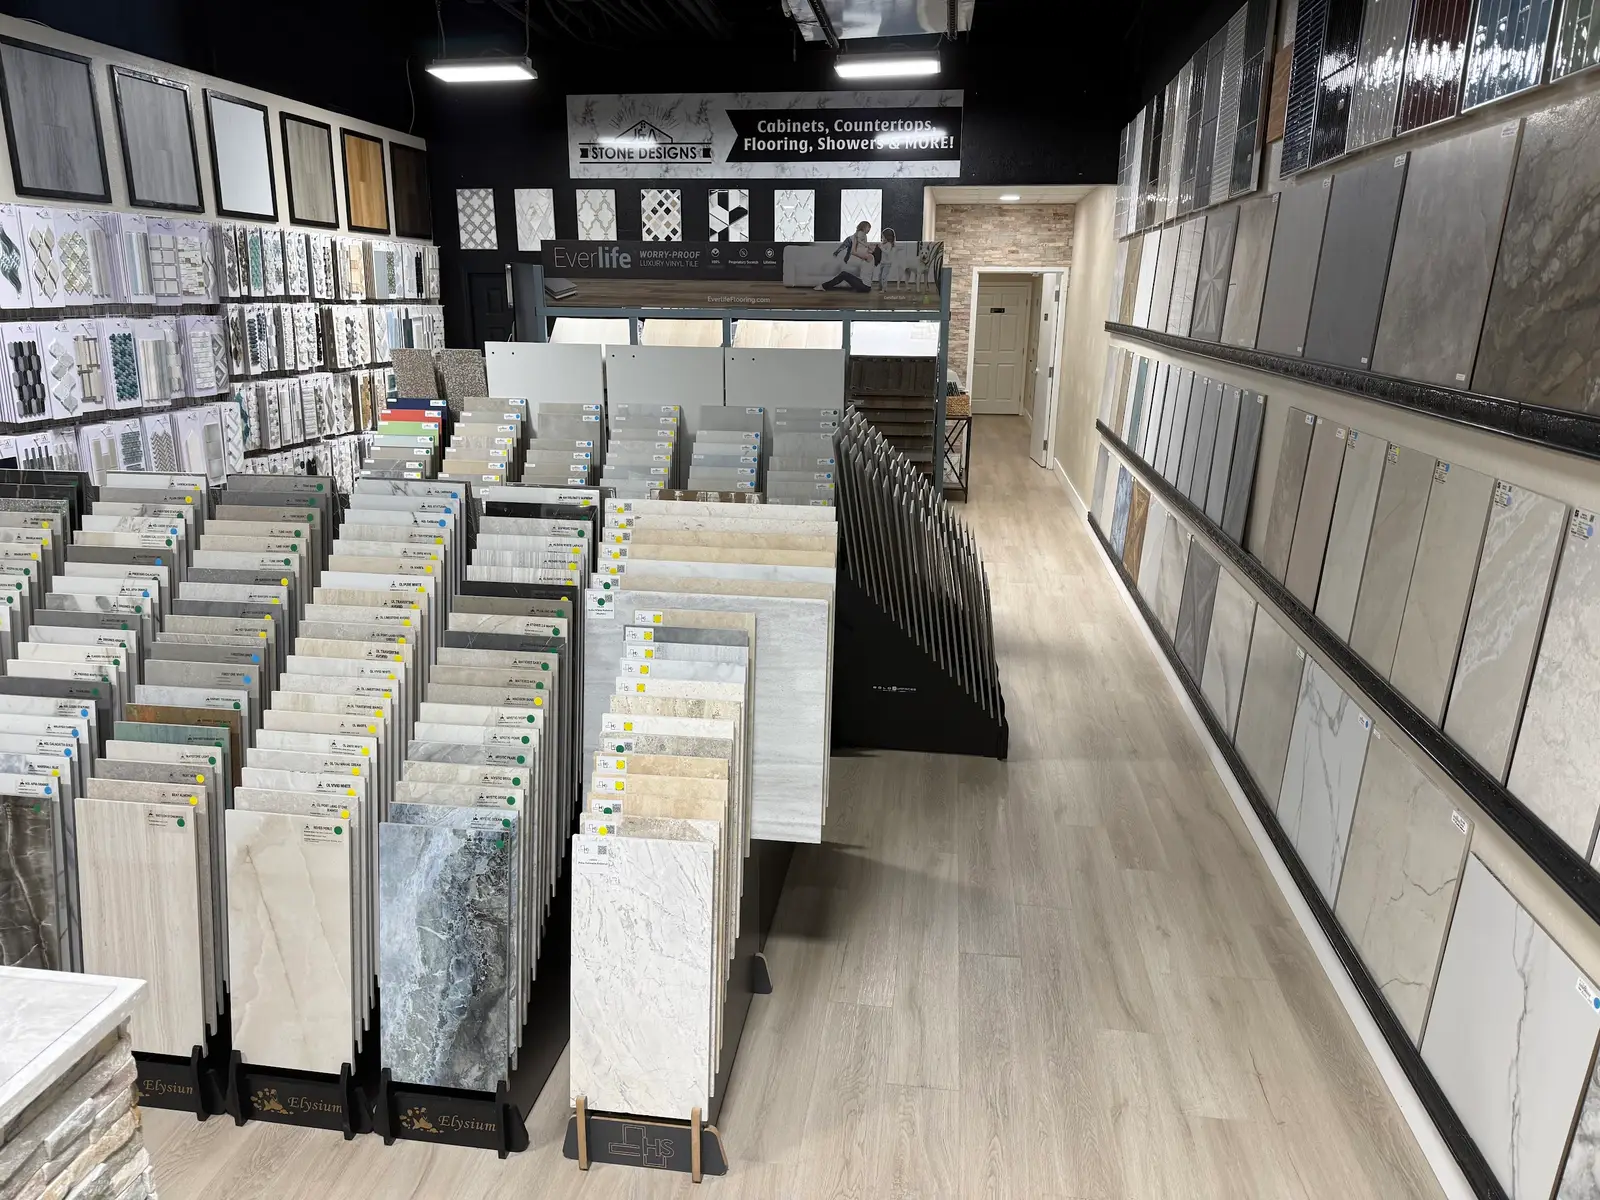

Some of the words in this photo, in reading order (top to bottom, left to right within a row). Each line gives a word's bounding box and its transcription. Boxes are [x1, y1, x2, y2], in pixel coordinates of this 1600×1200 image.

[757, 119, 829, 134] Cabinets,
[833, 118, 937, 133] Countertops,
[591, 147, 634, 159] STONE
[638, 146, 697, 160] DESIGNS
[743, 137, 813, 154] Flooring,
[817, 136, 884, 151] Showers
[905, 136, 954, 149] MORE!
[553, 246, 631, 269] Everlife
[639, 250, 701, 259] WORRY-PROOF
[287, 1096, 343, 1113] Elysium
[438, 1114, 496, 1131] Elysium
